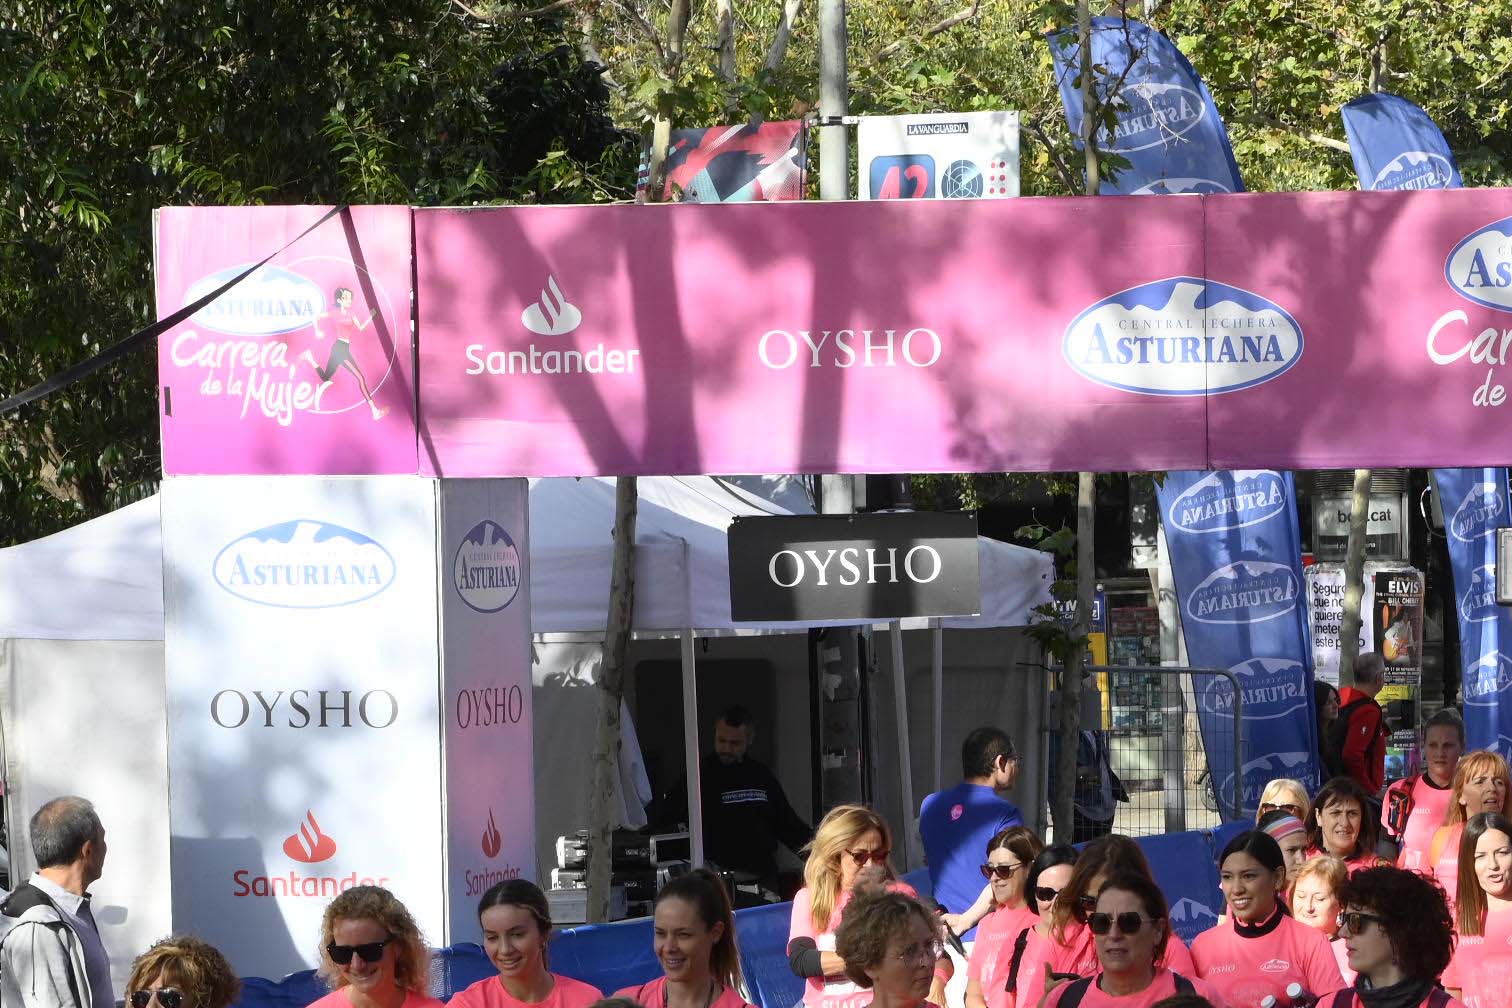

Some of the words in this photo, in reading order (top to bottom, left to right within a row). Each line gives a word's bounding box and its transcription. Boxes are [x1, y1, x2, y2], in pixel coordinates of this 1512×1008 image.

[1118, 318, 1193, 330] CENTRAL
[1201, 316, 1278, 330] LECHERA
[170, 329, 289, 368] Carrera
[465, 343, 639, 376] Santander
[758, 328, 943, 369] OYSHO
[1084, 321, 1286, 366] ASTURIANA
[200, 371, 223, 395] de
[226, 364, 243, 395] la
[240, 363, 334, 426] Mujer
[1472, 369, 1507, 407] de
[229, 553, 382, 587] ASTURIANA
[459, 559, 518, 591] ASTURIANA
[768, 545, 942, 588] OYSHO
[1314, 596, 1330, 609] que
[1388, 580, 1420, 594] ELVIS
[1314, 610, 1343, 624] quiere
[1316, 636, 1334, 648] este
[210, 689, 399, 729] OYSHO
[456, 684, 523, 730] OYSHO
[1208, 964, 1237, 975] OYSHO
